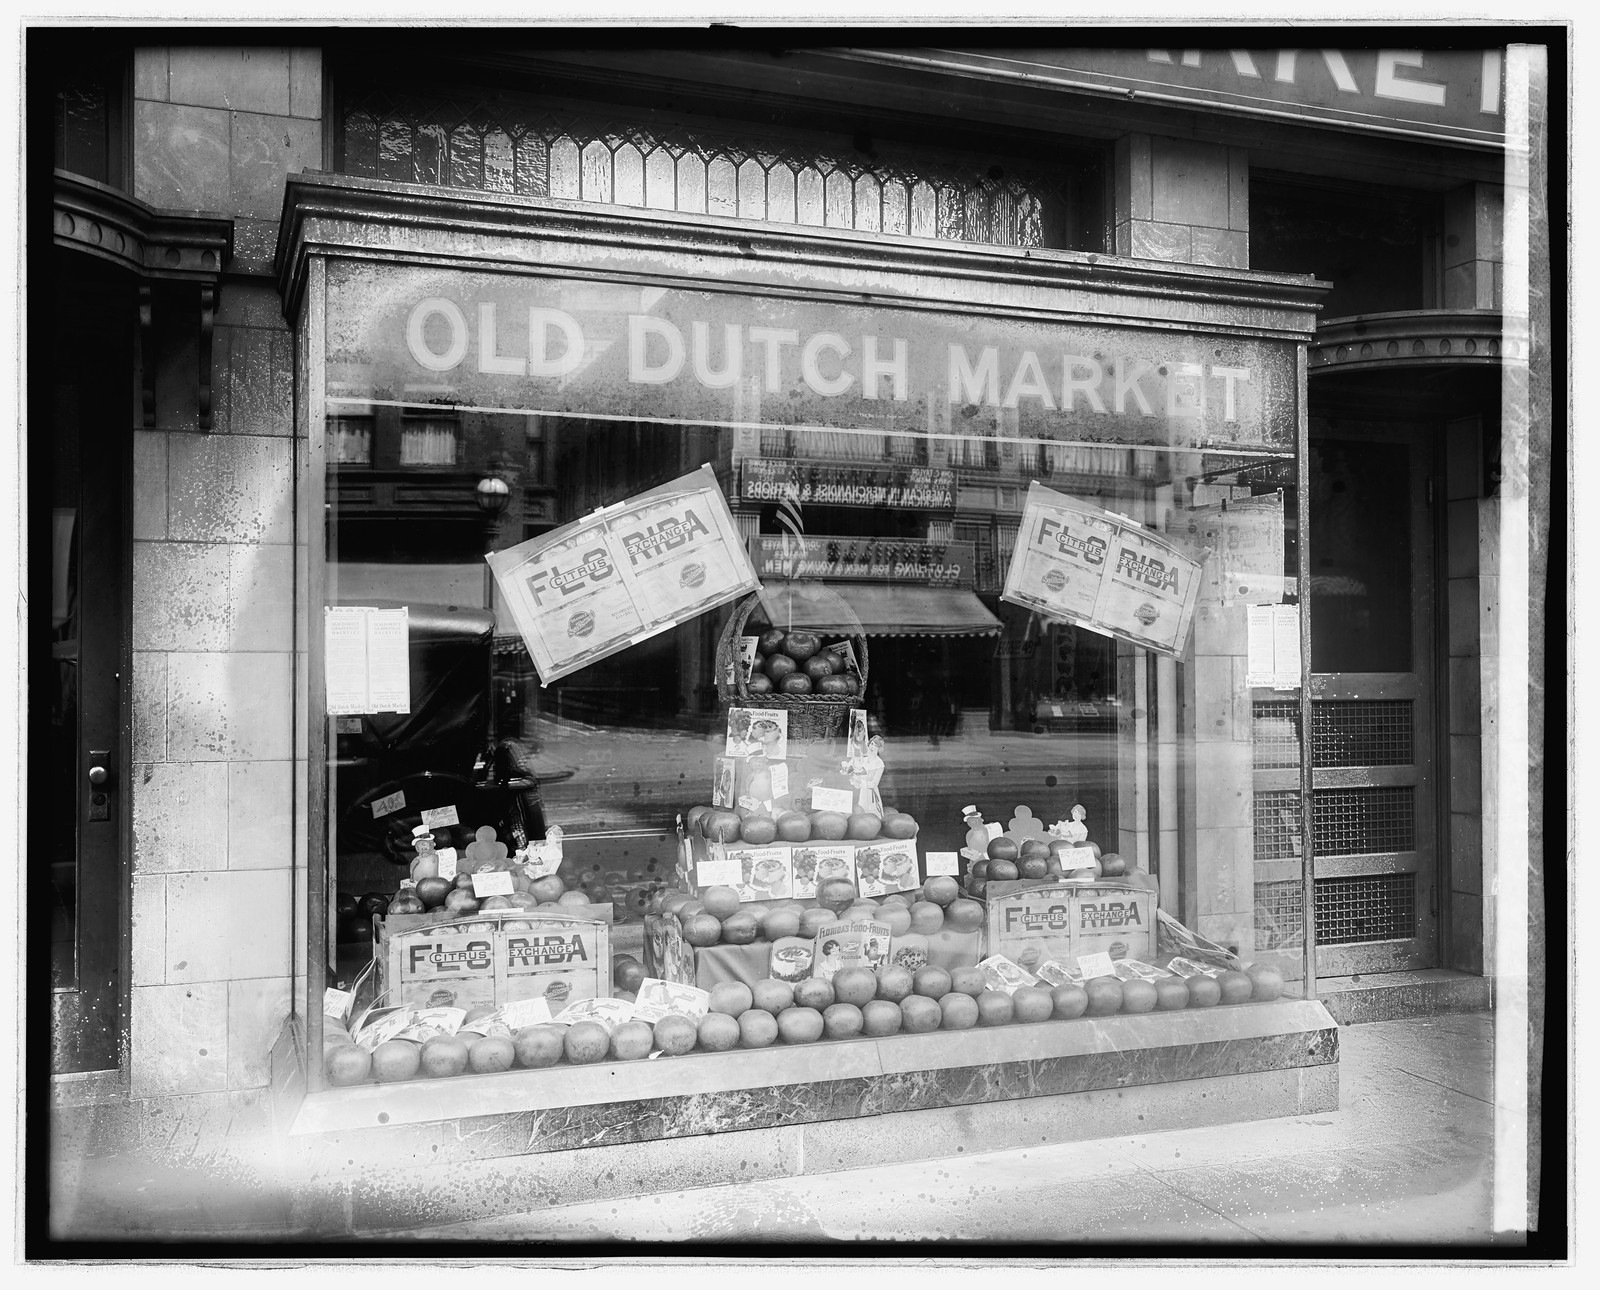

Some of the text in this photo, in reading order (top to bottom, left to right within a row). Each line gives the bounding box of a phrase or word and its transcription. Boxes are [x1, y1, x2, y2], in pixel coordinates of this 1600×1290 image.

[406, 297, 1251, 423] OLD DUTCH MARKET
[553, 521, 691, 587] CITRUS EXCHANGE
[1059, 534, 1170, 582] CITRUS EXCHANGE
[850, 923, 889, 936] FOOD-FRUITS
[1024, 909, 1129, 922] CITRUS EXCHANGE
[433, 944, 572, 962] CITRUS EXCHANGE
